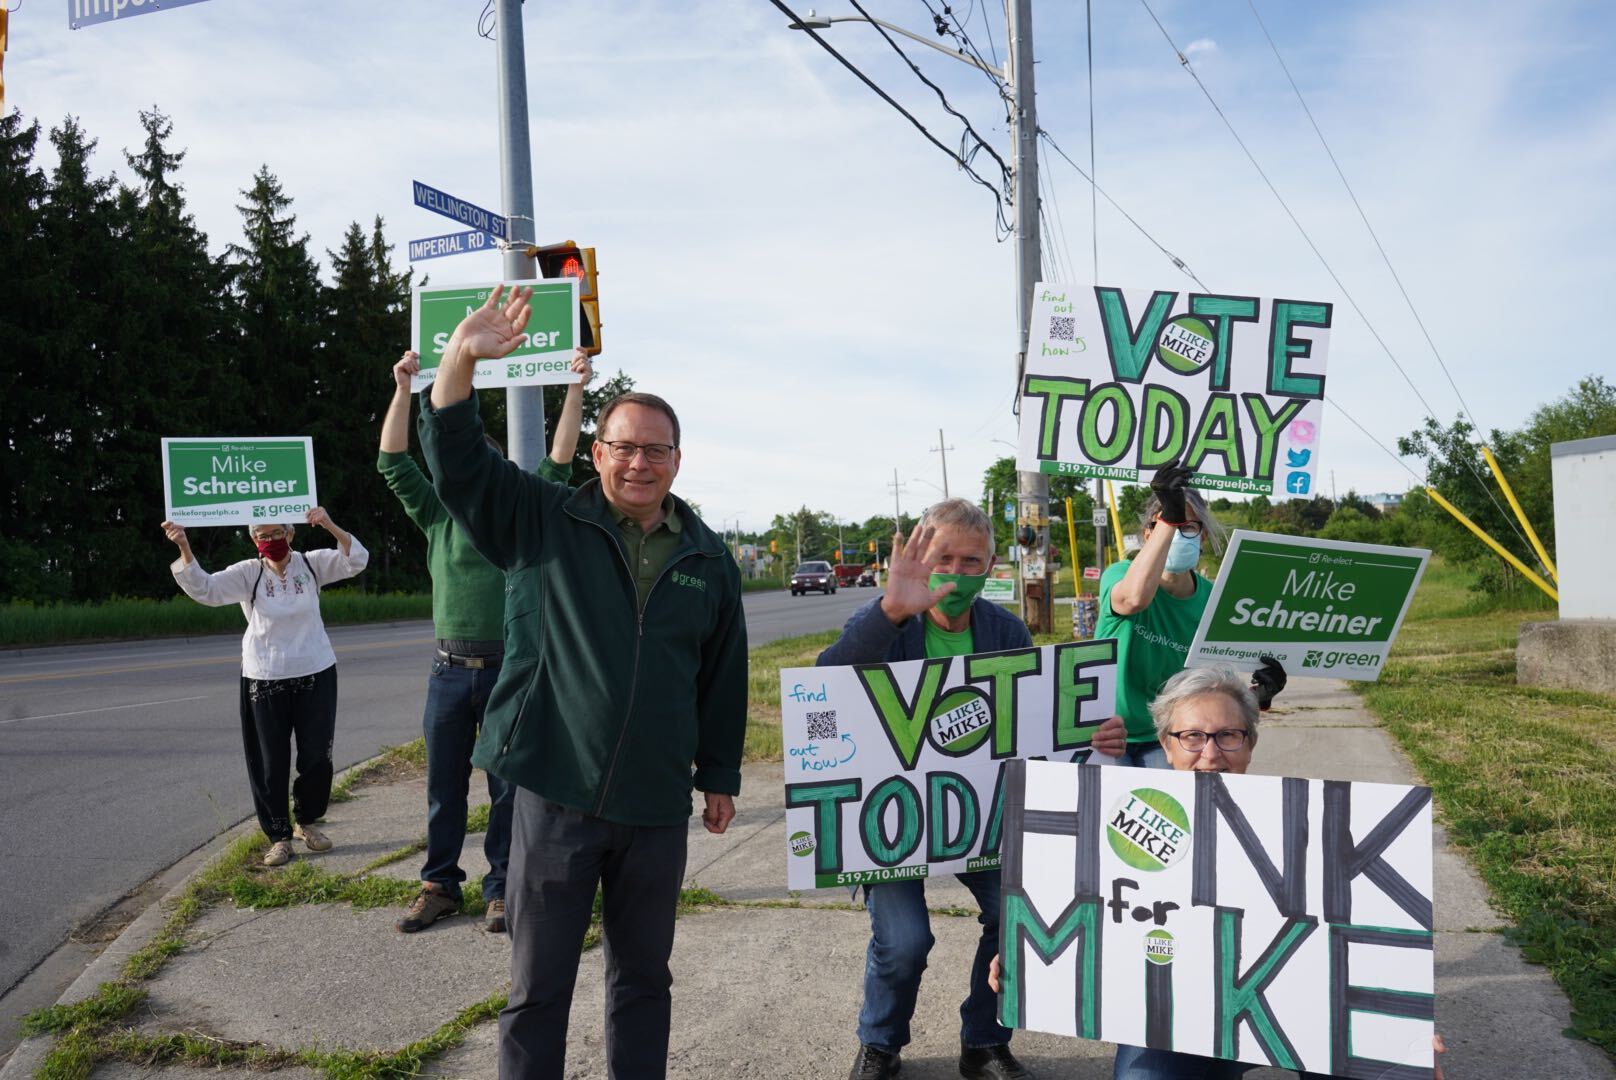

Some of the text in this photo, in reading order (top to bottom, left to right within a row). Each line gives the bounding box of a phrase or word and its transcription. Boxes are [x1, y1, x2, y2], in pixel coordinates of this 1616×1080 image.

[415, 184, 504, 236] WELLINGTON ST
[411, 236, 463, 258] IMPERIAL
[468, 232, 484, 249] RD
[1040, 290, 1066, 302] find
[1054, 302, 1075, 313] out
[1094, 286, 1333, 401] VOTE
[1169, 324, 1209, 350] I LIKE
[1042, 342, 1069, 356] how
[1161, 334, 1206, 363] MIKE
[525, 360, 572, 376] green
[1024, 374, 1310, 480] TODAY
[212, 455, 267, 473] Mike
[183, 476, 297, 495] Schreiner
[1058, 463, 1271, 494] 519.710.MIKE keforguelph.ca
[171, 503, 311, 517] mikeforguelph.ca green
[1095, 516, 1106, 524] 60
[1321, 554, 1353, 565] Re-elect
[680, 574, 706, 592] green
[1281, 569, 1356, 601] Mike
[1229, 598, 1382, 635] Schreiner
[1323, 651, 1380, 668] green
[789, 683, 827, 702] find
[852, 638, 1118, 771] VOTE
[935, 700, 981, 729] I LIKE
[938, 710, 989, 745] MIKE
[790, 744, 819, 756] out
[802, 757, 837, 771] how
[1125, 797, 1184, 845] I LIKE
[791, 841, 814, 852] MIKE
[1001, 759, 1433, 931] HONK
[1111, 809, 1176, 864] MIKE
[836, 853, 1003, 884] 519.710.MIKE mikef
[1107, 877, 1180, 926] for
[1147, 945, 1174, 956] MIKE
[1154, 938, 1173, 947] LIKE
